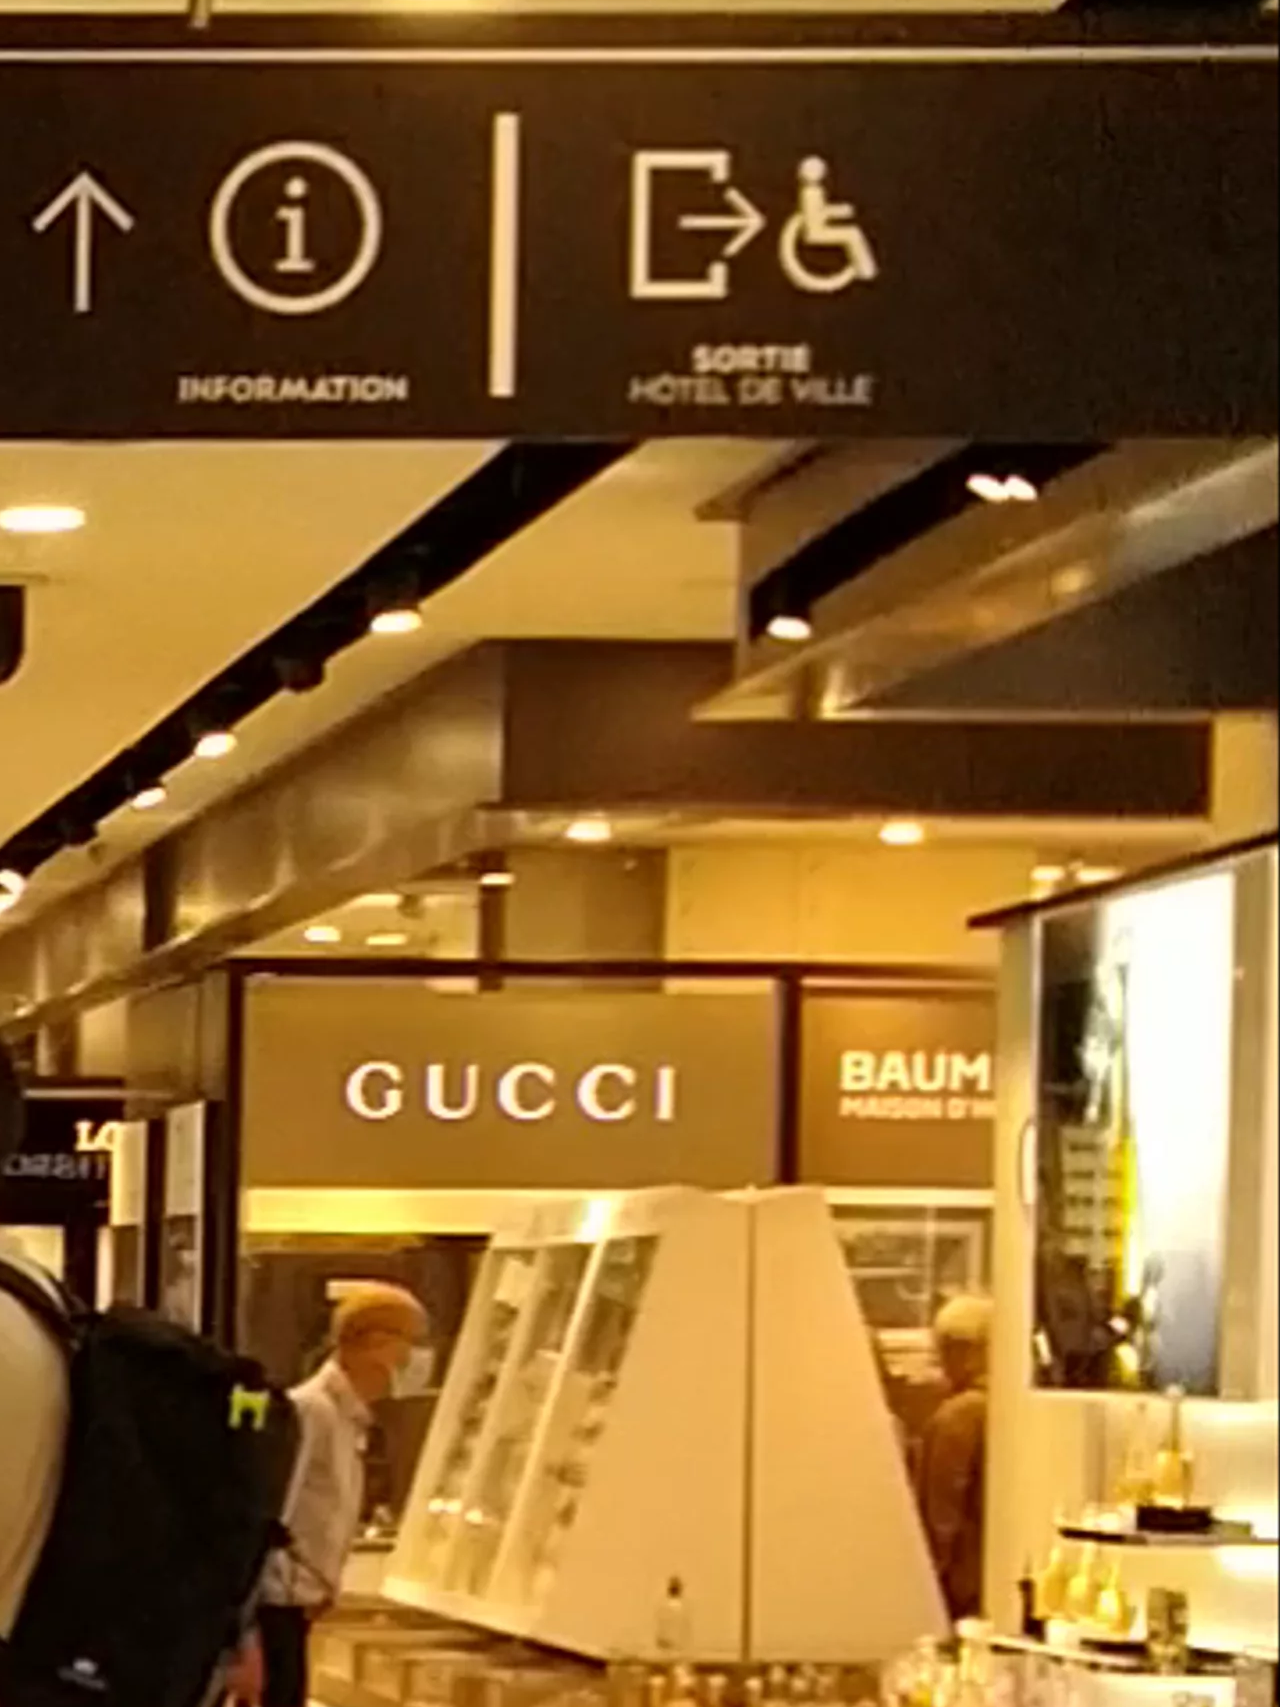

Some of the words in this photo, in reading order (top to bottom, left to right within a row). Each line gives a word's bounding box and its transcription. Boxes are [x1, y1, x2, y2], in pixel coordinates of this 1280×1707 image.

[693, 344, 810, 373] SORTIE
[178, 374, 408, 402] INFORMATION
[738, 377, 782, 406] DE
[791, 375, 874, 406] VILLE
[840, 1050, 991, 1091] BAUM
[345, 1060, 676, 1121] GUCCI
[839, 1096, 943, 1120] MAISON
